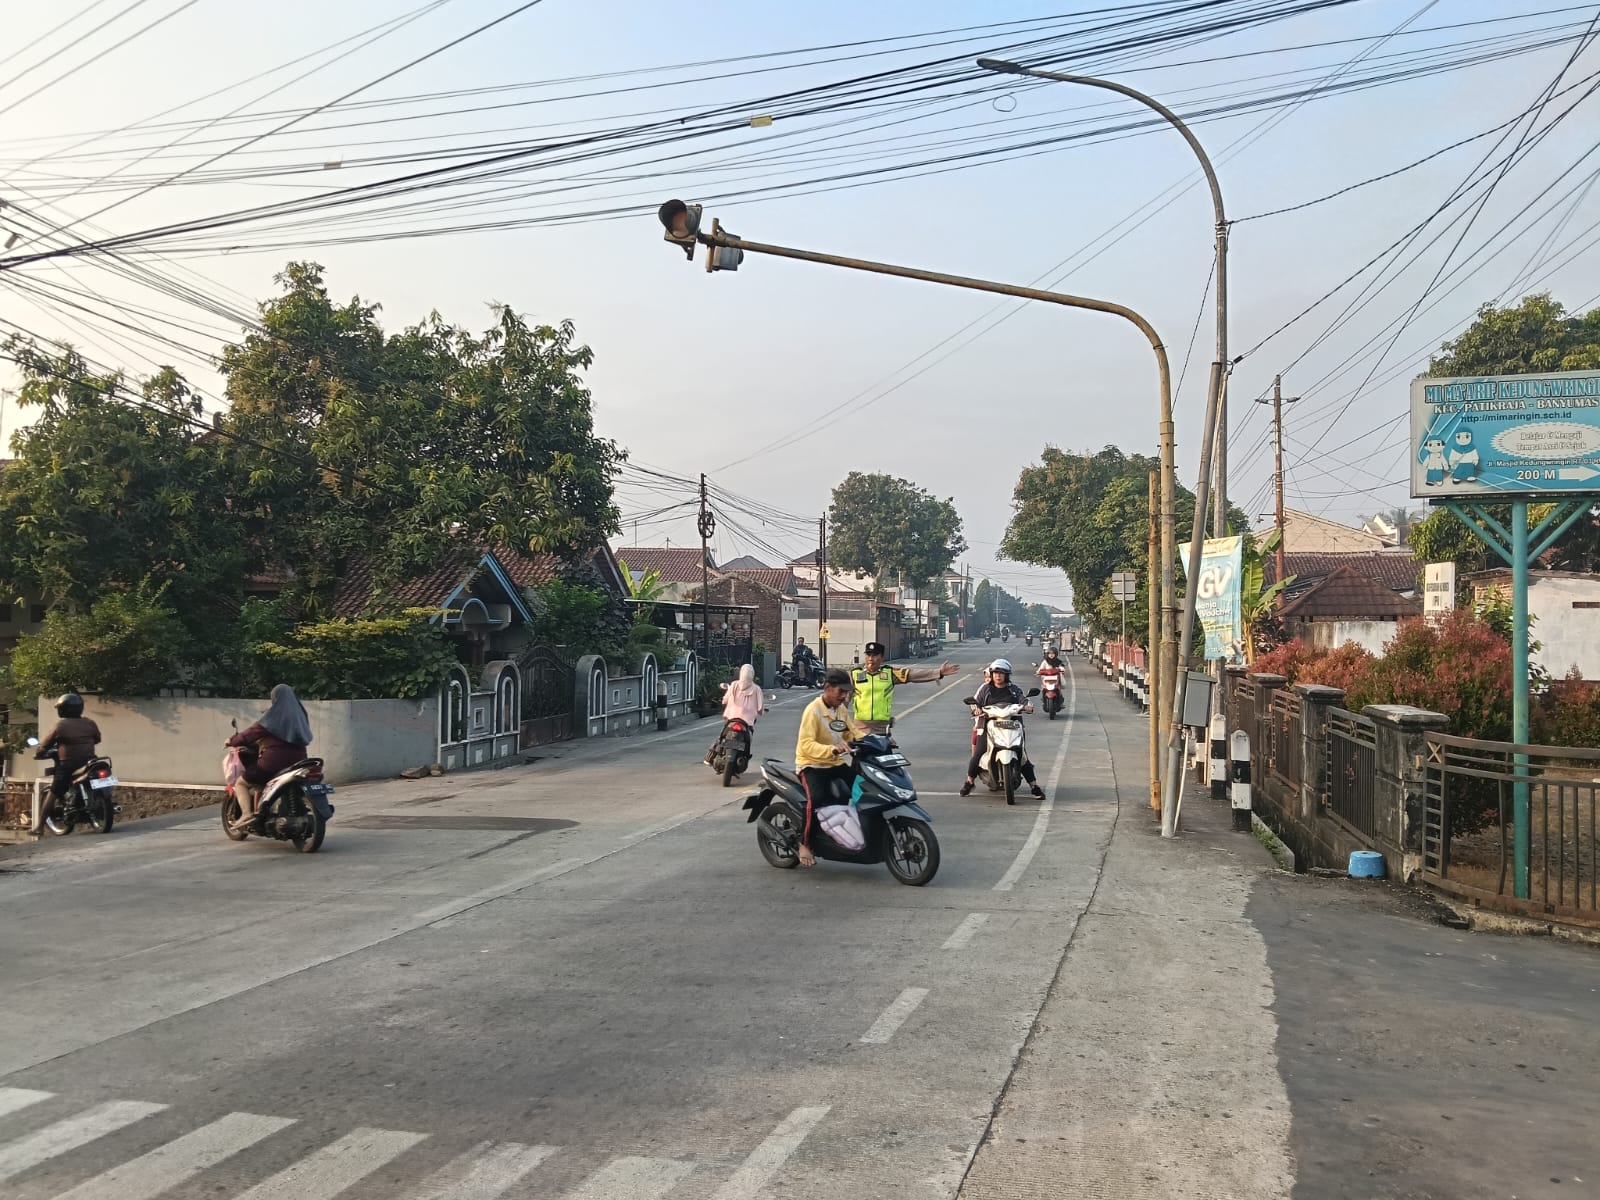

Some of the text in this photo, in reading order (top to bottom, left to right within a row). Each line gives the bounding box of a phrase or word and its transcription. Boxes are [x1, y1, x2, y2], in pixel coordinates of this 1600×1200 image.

[1425, 385, 1442, 403] MI
[1444, 381, 1497, 403] MA'ARIF
[1434, 404, 1459, 414] KEC.
[1464, 400, 1526, 412] PATIKRAJA
[1537, 398, 1600, 409] BANYUMAS
[1460, 411, 1573, 423] http://mimaringin.sch.id
[1496, 459, 1519, 468] Masjid
[1516, 469, 1556, 480] 200 M
